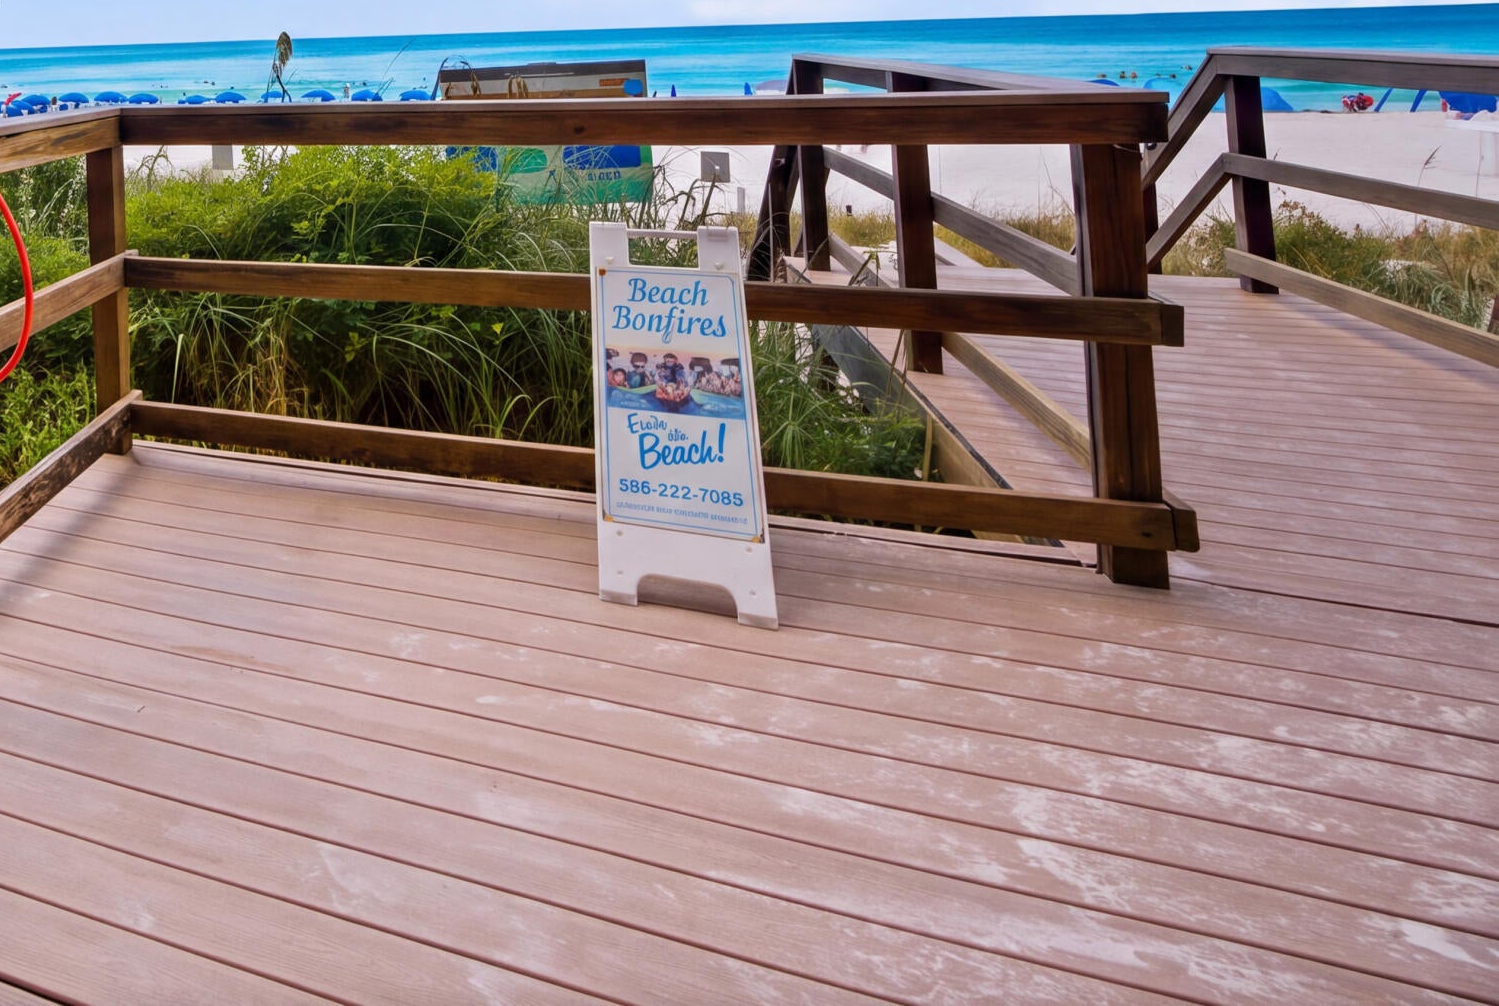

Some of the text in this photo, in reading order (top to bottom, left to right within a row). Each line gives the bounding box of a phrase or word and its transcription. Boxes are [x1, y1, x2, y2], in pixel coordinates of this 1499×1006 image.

[628, 278, 708, 306] Beach
[612, 305, 727, 344] Bonfires
[638, 422, 726, 470] Beach!
[619, 478, 744, 507] 586-222-7085
